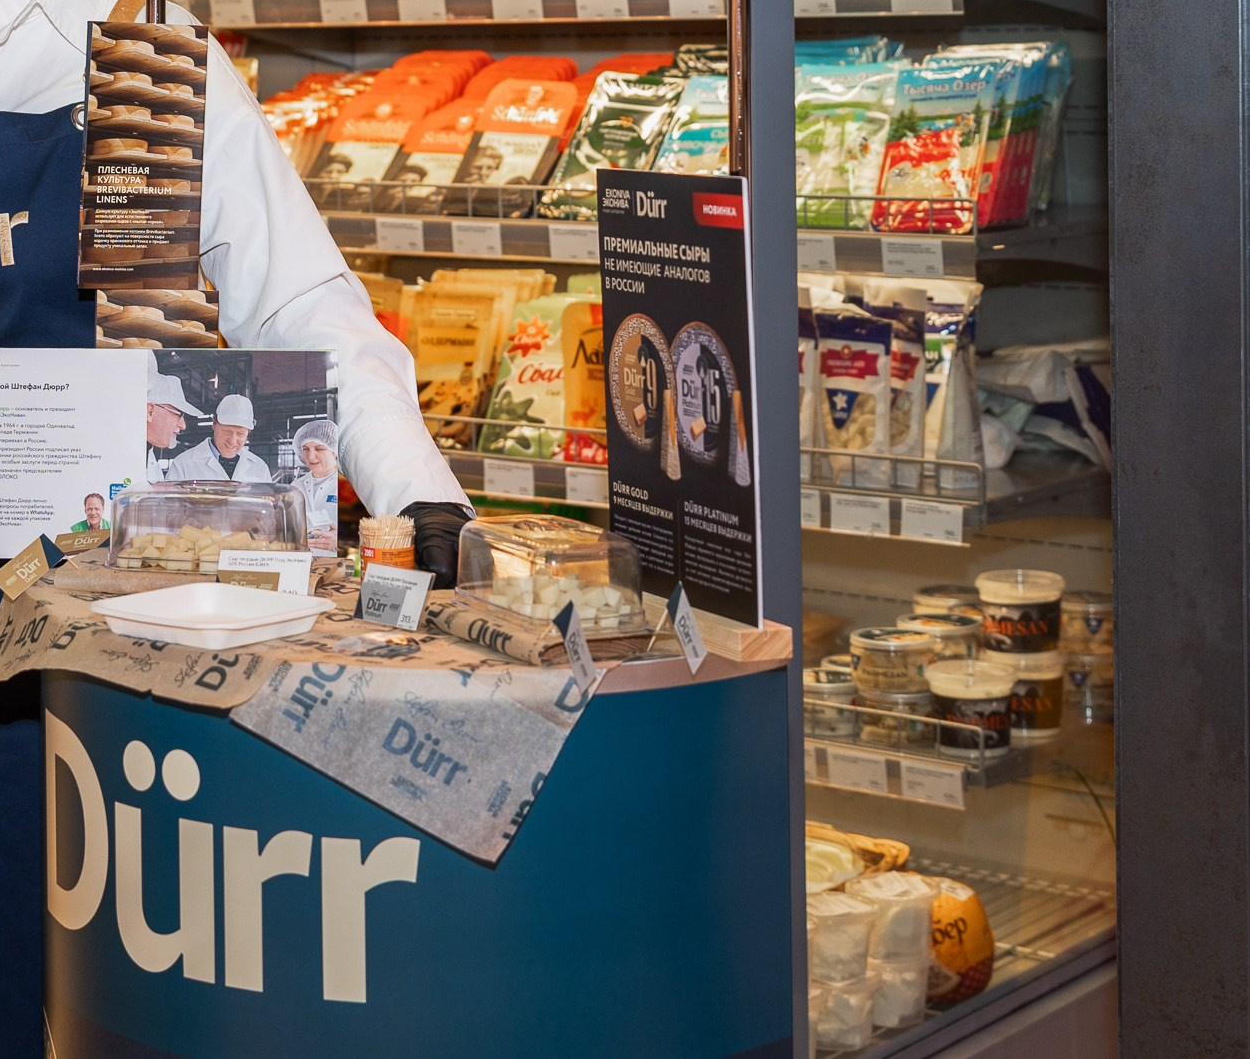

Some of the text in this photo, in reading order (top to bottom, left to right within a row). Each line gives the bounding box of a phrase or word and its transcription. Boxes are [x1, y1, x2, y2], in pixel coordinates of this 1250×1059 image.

[97, 165, 150, 175] ПЛЕСНЕВАЯ
[97, 175, 142, 184] КУЛЬТУРА
[96, 185, 172, 195] BREVIBACTERIUM
[605, 188, 631, 200] EKONIVA
[96, 195, 128, 204] LINENS
[602, 197, 629, 209] ЭКОНИВА
[636, 190, 668, 219] Dürr
[702, 204, 738, 217] НОВИНКА
[603, 236, 711, 263] ПРЕМИАЛЬНЫЕ СЫРЫ
[604, 258, 711, 284] НЕ ИМЕЮЩИЕ АНАЛОГОВ
[605, 277, 645, 294] В РОССИИ
[11, 383, 42, 391] Штефан
[43, 383, 70, 391] Дюрр?
[613, 481, 649, 501] DÜRR GOLD
[613, 495, 673, 521] 9 МЕСЯЦЕВ ВЫДЕРЖКИ
[684, 500, 739, 526] DÜRR PLATINUM
[684, 516, 752, 543] 15 МЕСЯЦЕВ ВЫДЕРЖКИ
[74, 536, 101, 546] Dürr
[16, 557, 41, 580] Dürr
[24, 573, 37, 583] Gold
[366, 597, 388, 613] Dürr
[678, 614, 693, 645] Dürr
[282, 662, 347, 733] Dürr
[382, 716, 468, 786] Dürr
[45, 707, 421, 1003] Dürr
